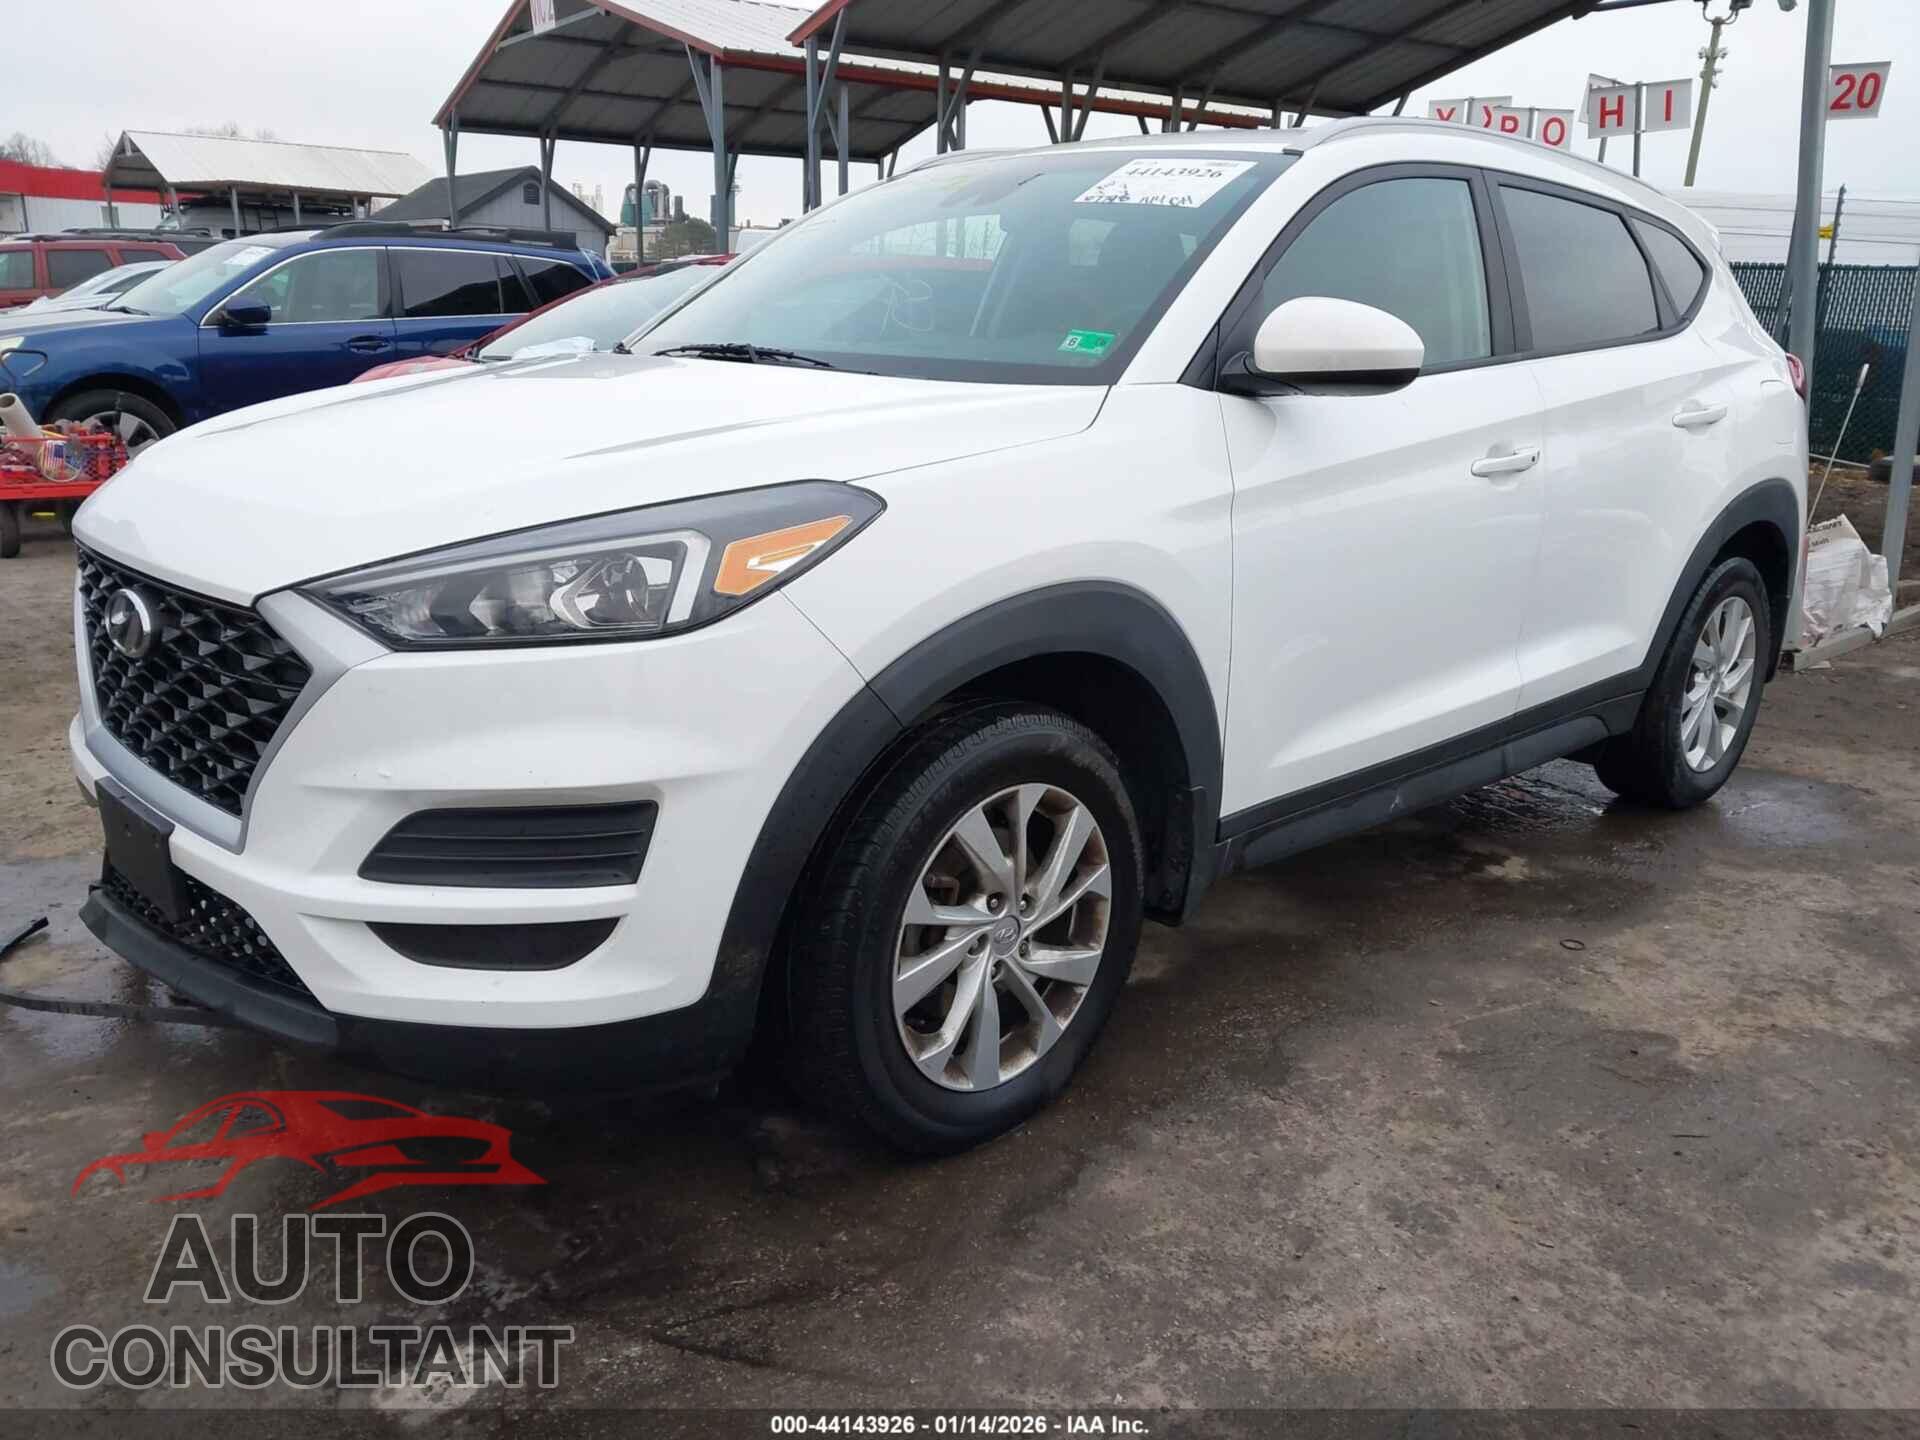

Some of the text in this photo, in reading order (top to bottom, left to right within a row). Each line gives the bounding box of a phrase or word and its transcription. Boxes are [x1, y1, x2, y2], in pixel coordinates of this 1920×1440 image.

[1600, 89, 1673, 128] H I
[1830, 72, 1881, 111] 20
